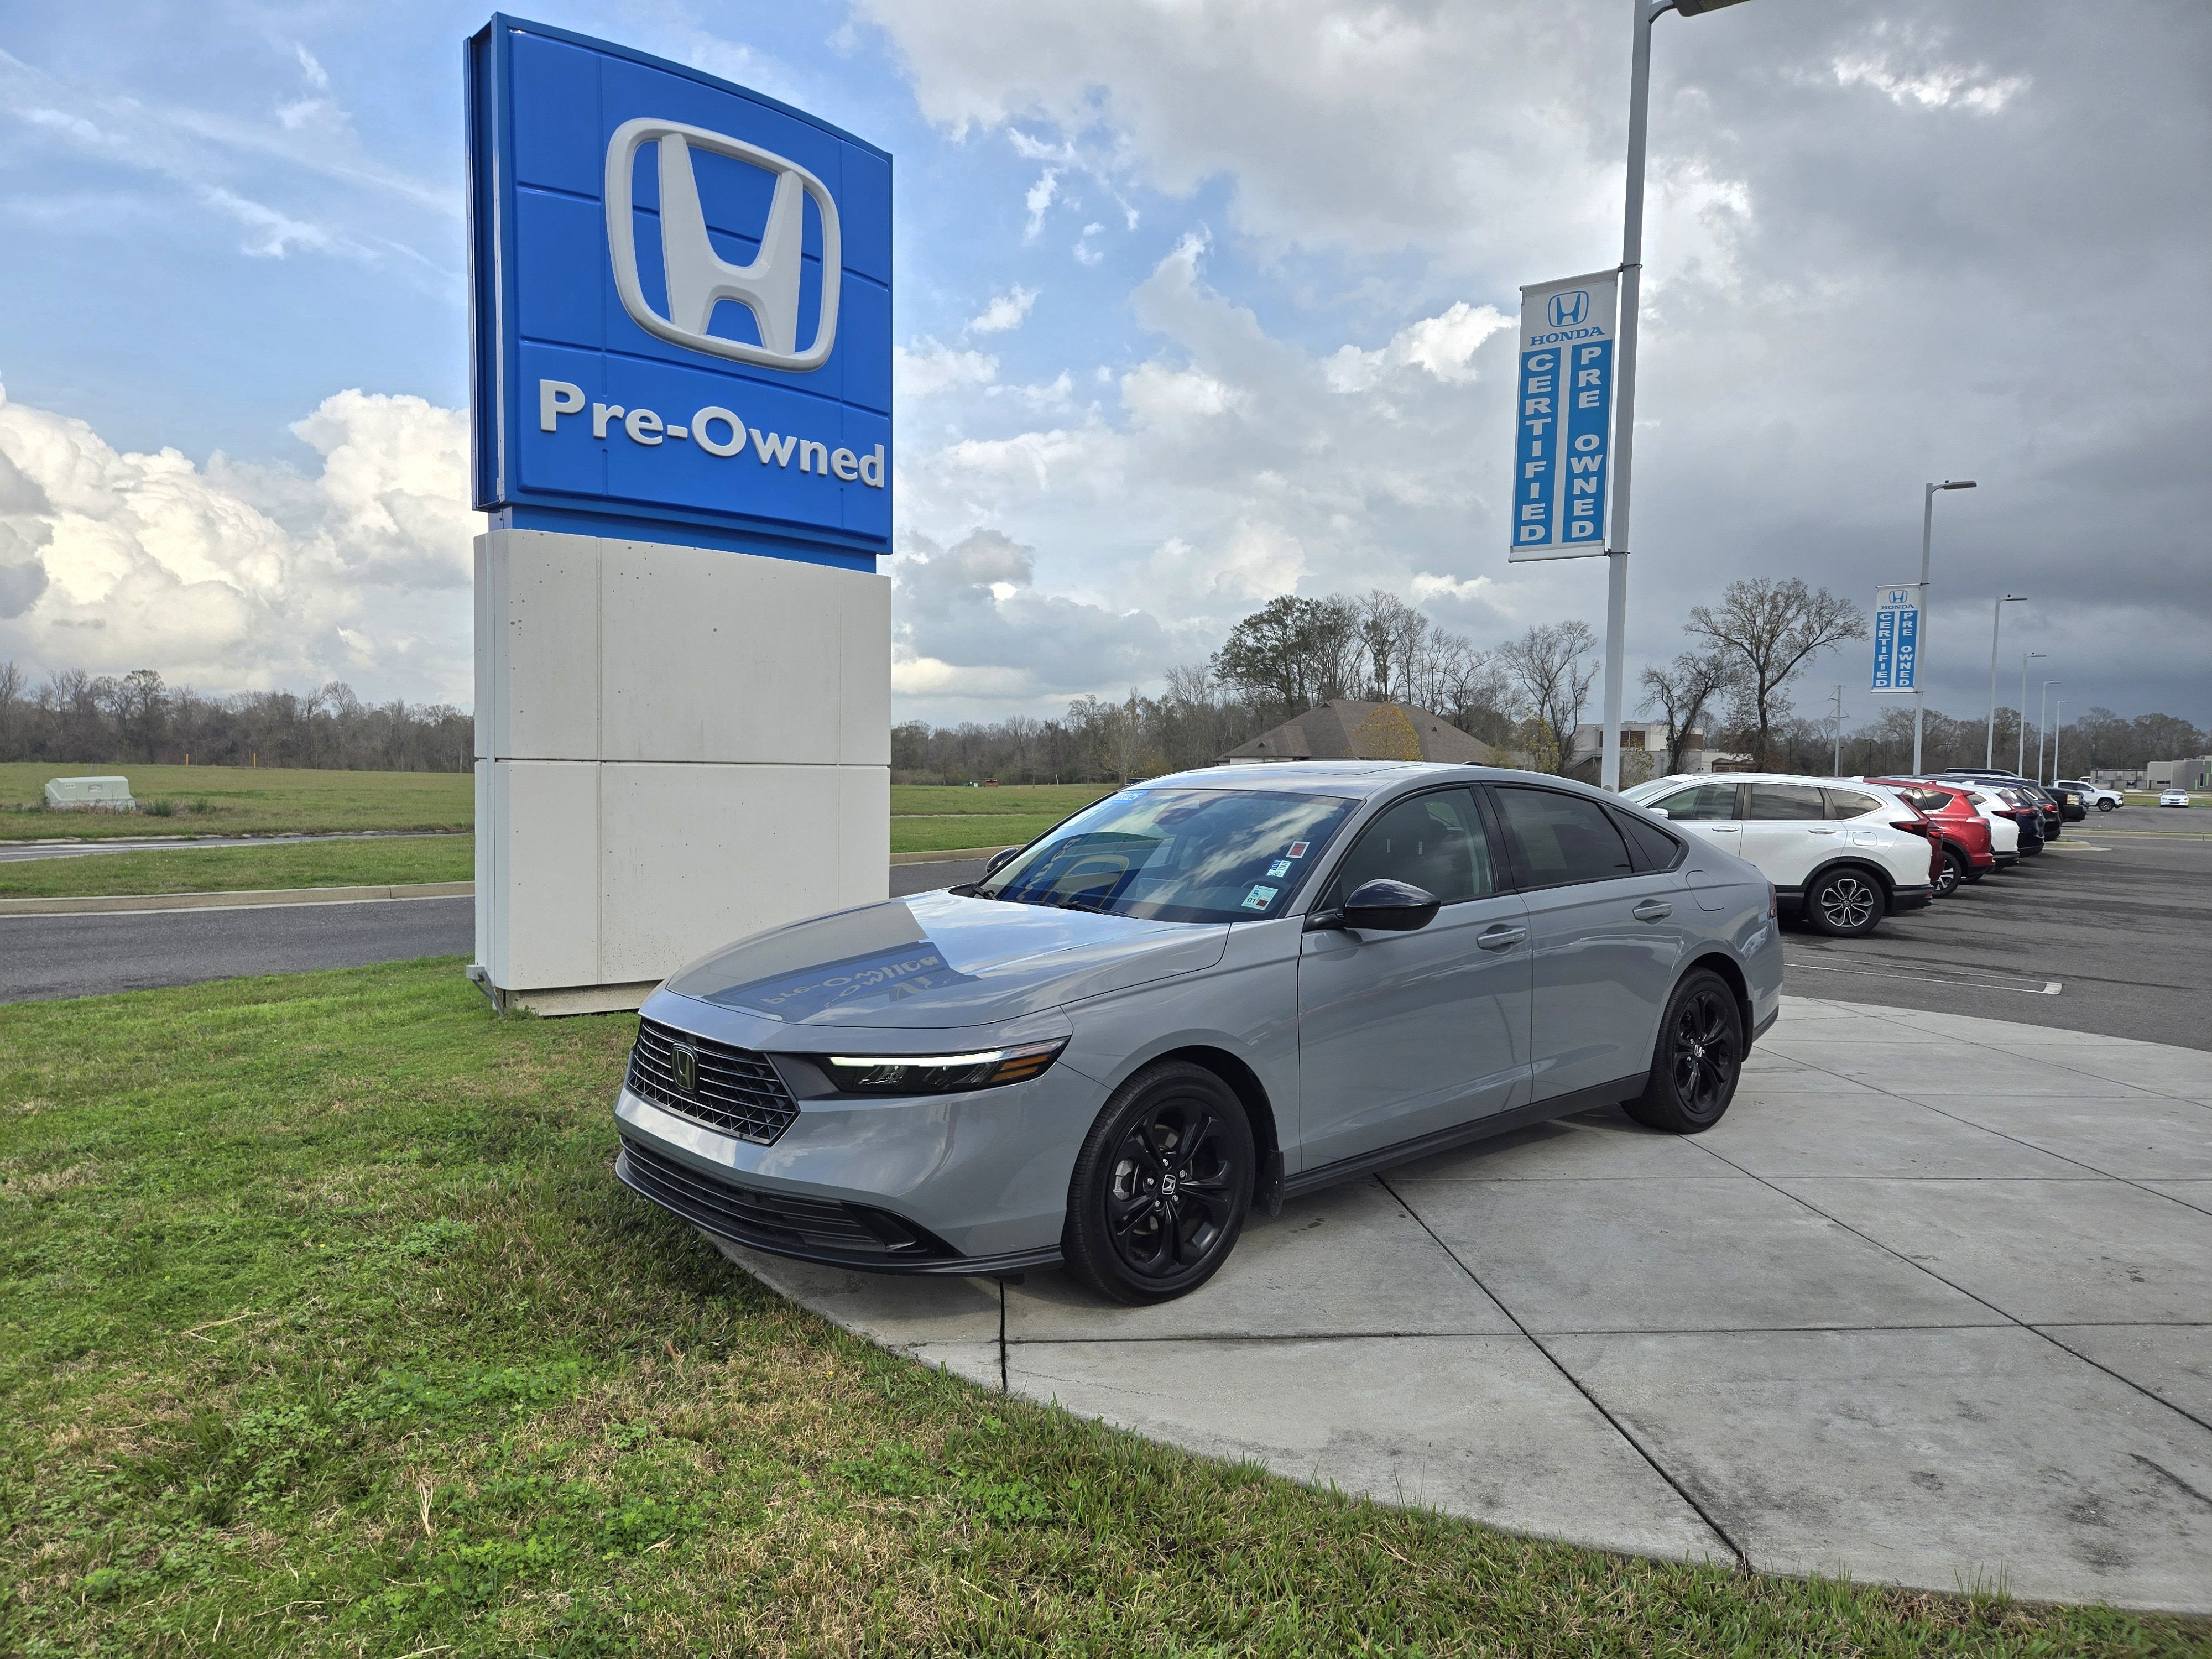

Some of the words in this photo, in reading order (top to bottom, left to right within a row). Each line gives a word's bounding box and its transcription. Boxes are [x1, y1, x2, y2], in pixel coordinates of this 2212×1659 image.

[1530, 326, 1605, 346] HONDA
[1578, 347, 1602, 409] PRE
[539, 378, 885, 489] Pre-Owned
[1520, 354, 1554, 542] CERTIFIED
[1570, 434, 1603, 539] OWNED
[1876, 613, 1892, 686] CERTIFIED
[1902, 612, 1913, 636] PRE
[1898, 646, 1913, 686] OWNED
